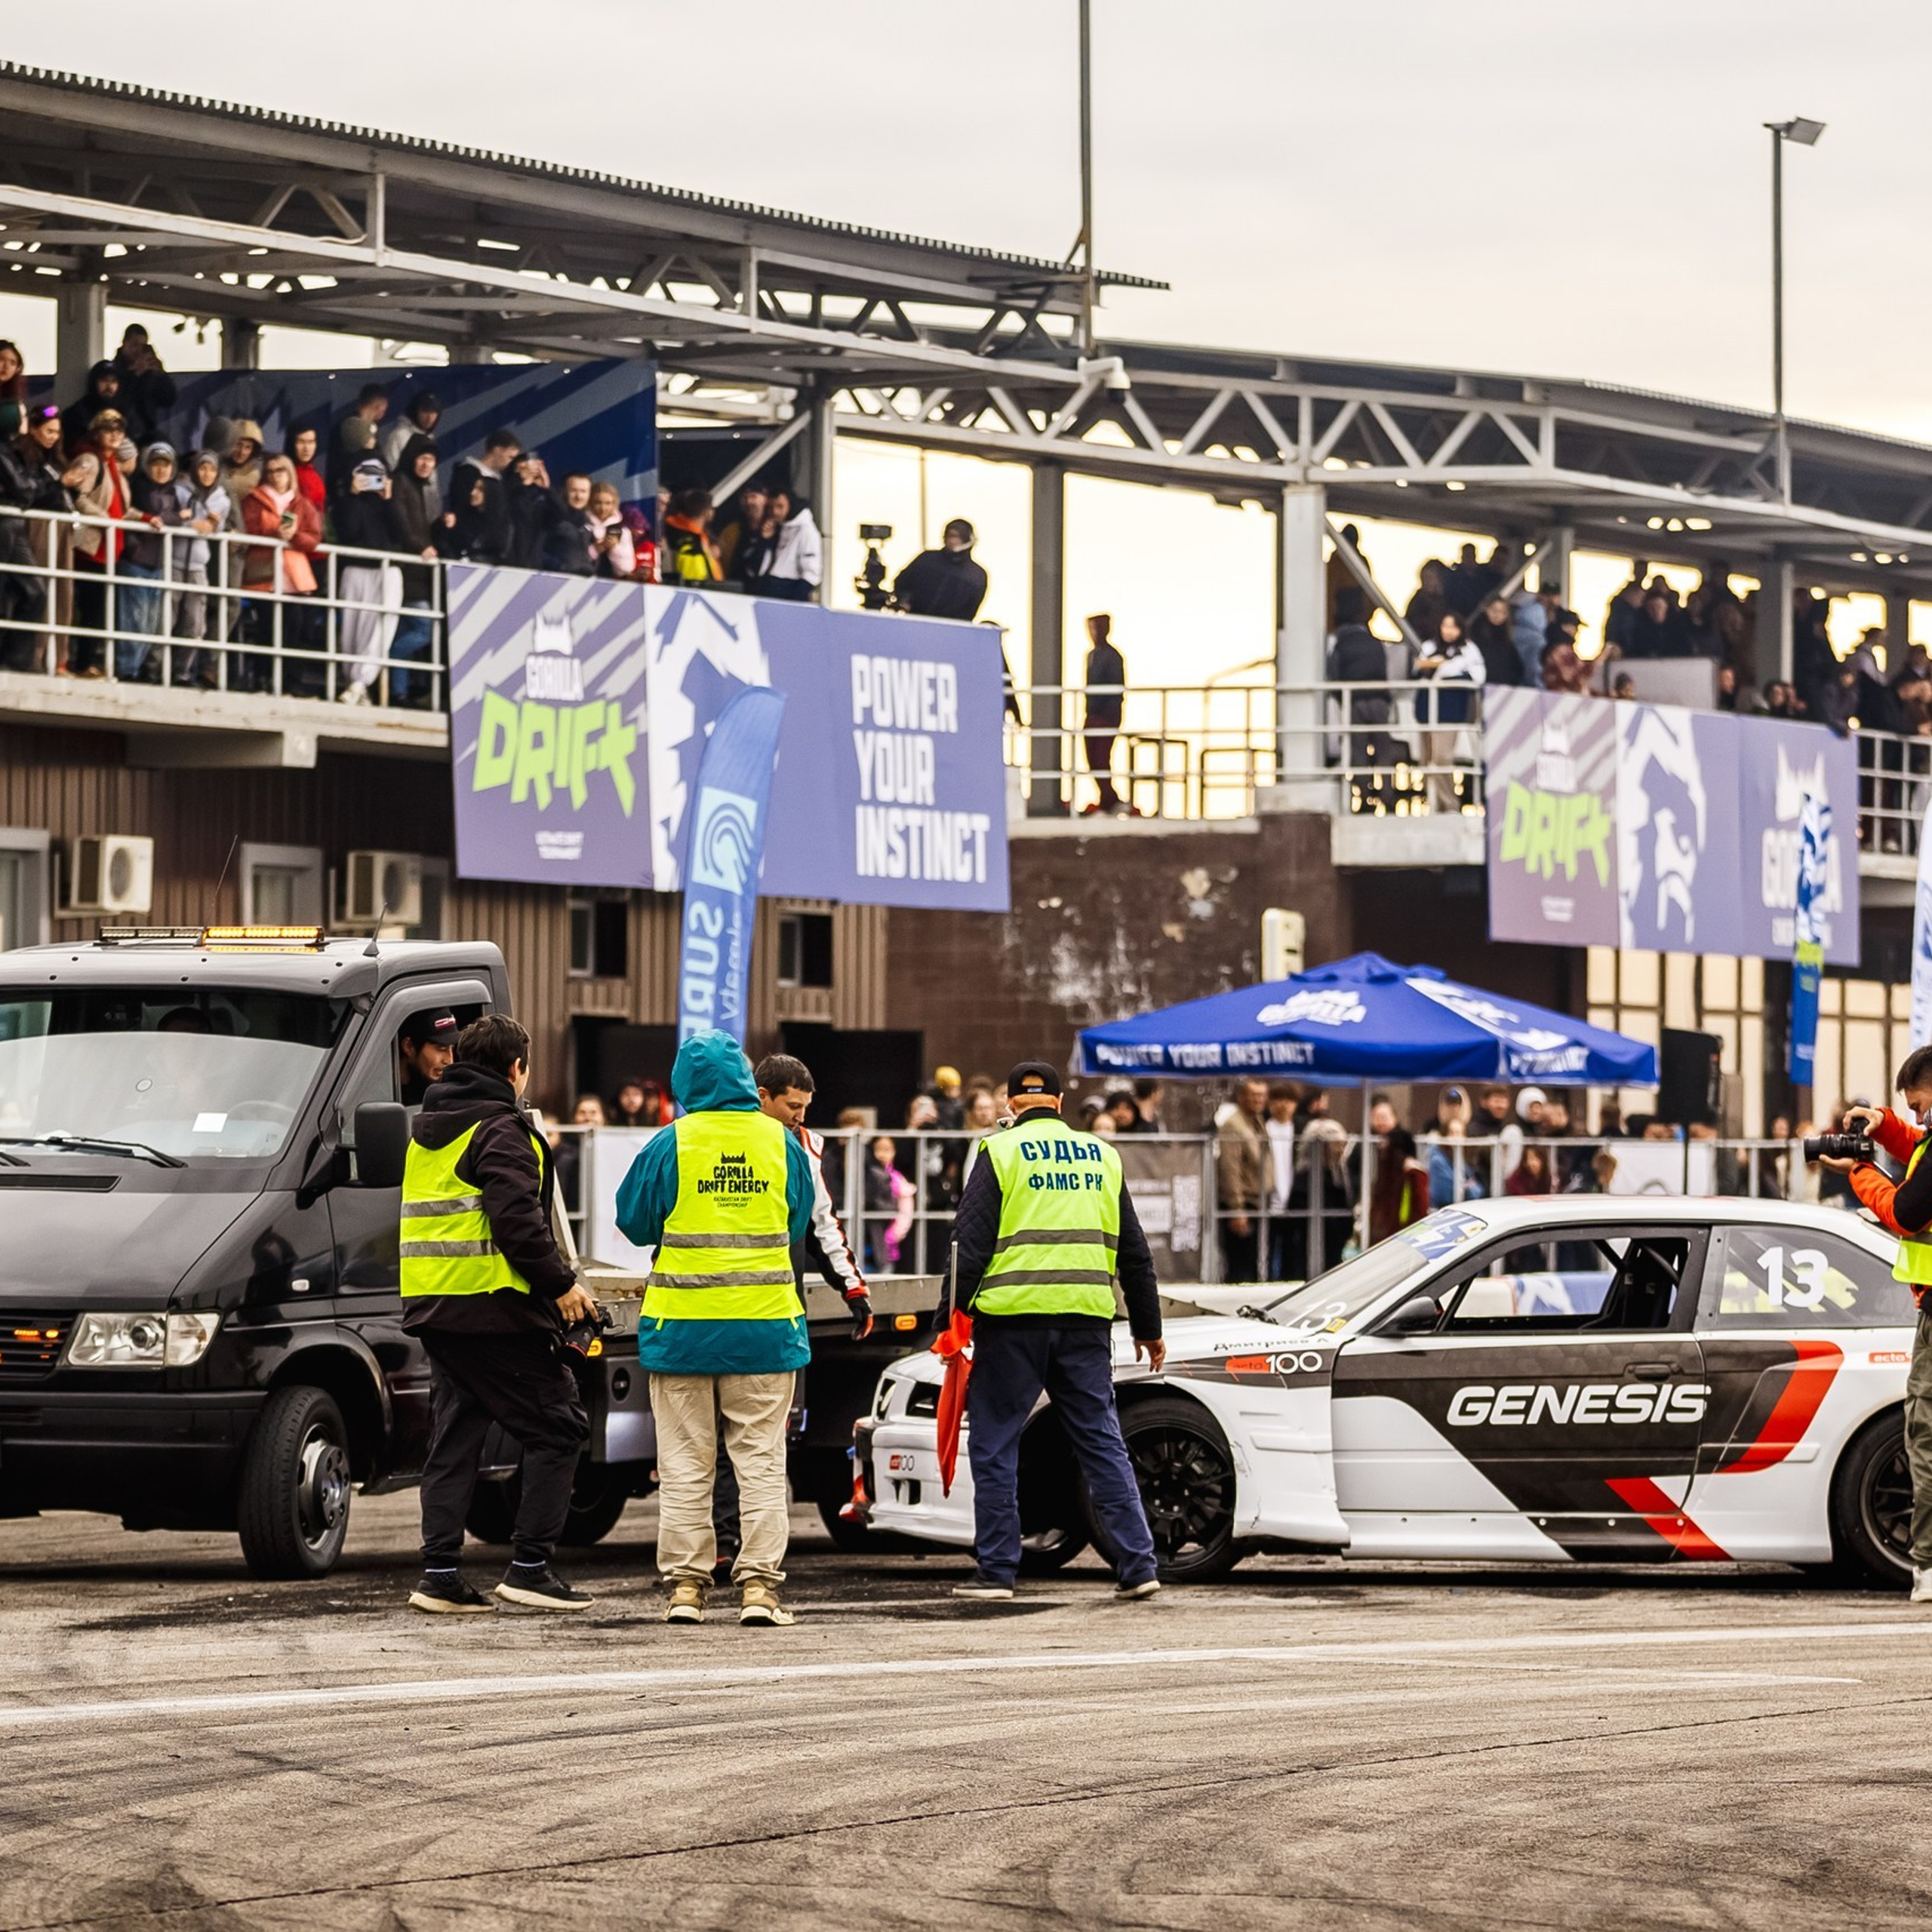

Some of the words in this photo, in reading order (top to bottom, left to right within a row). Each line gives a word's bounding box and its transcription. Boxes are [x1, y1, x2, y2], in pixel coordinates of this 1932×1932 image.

[851, 654, 958, 734] POWER
[472, 690, 637, 818] DRIFT
[853, 729, 935, 806] YOUR
[855, 804, 990, 883] INSTINCT
[1225, 1041, 1315, 1067] INSTINCT
[713, 1165, 754, 1180] GORILLA
[1020, 1140, 1102, 1164] СУДЬЯ
[697, 1180, 726, 1194] DRIFT
[728, 1180, 769, 1195] ENERGY
[1029, 1172, 1080, 1191] ФАМС
[1084, 1173, 1103, 1192] РК
[1756, 1246, 1829, 1309] 13
[1447, 1383, 1711, 1426] GENESIS
